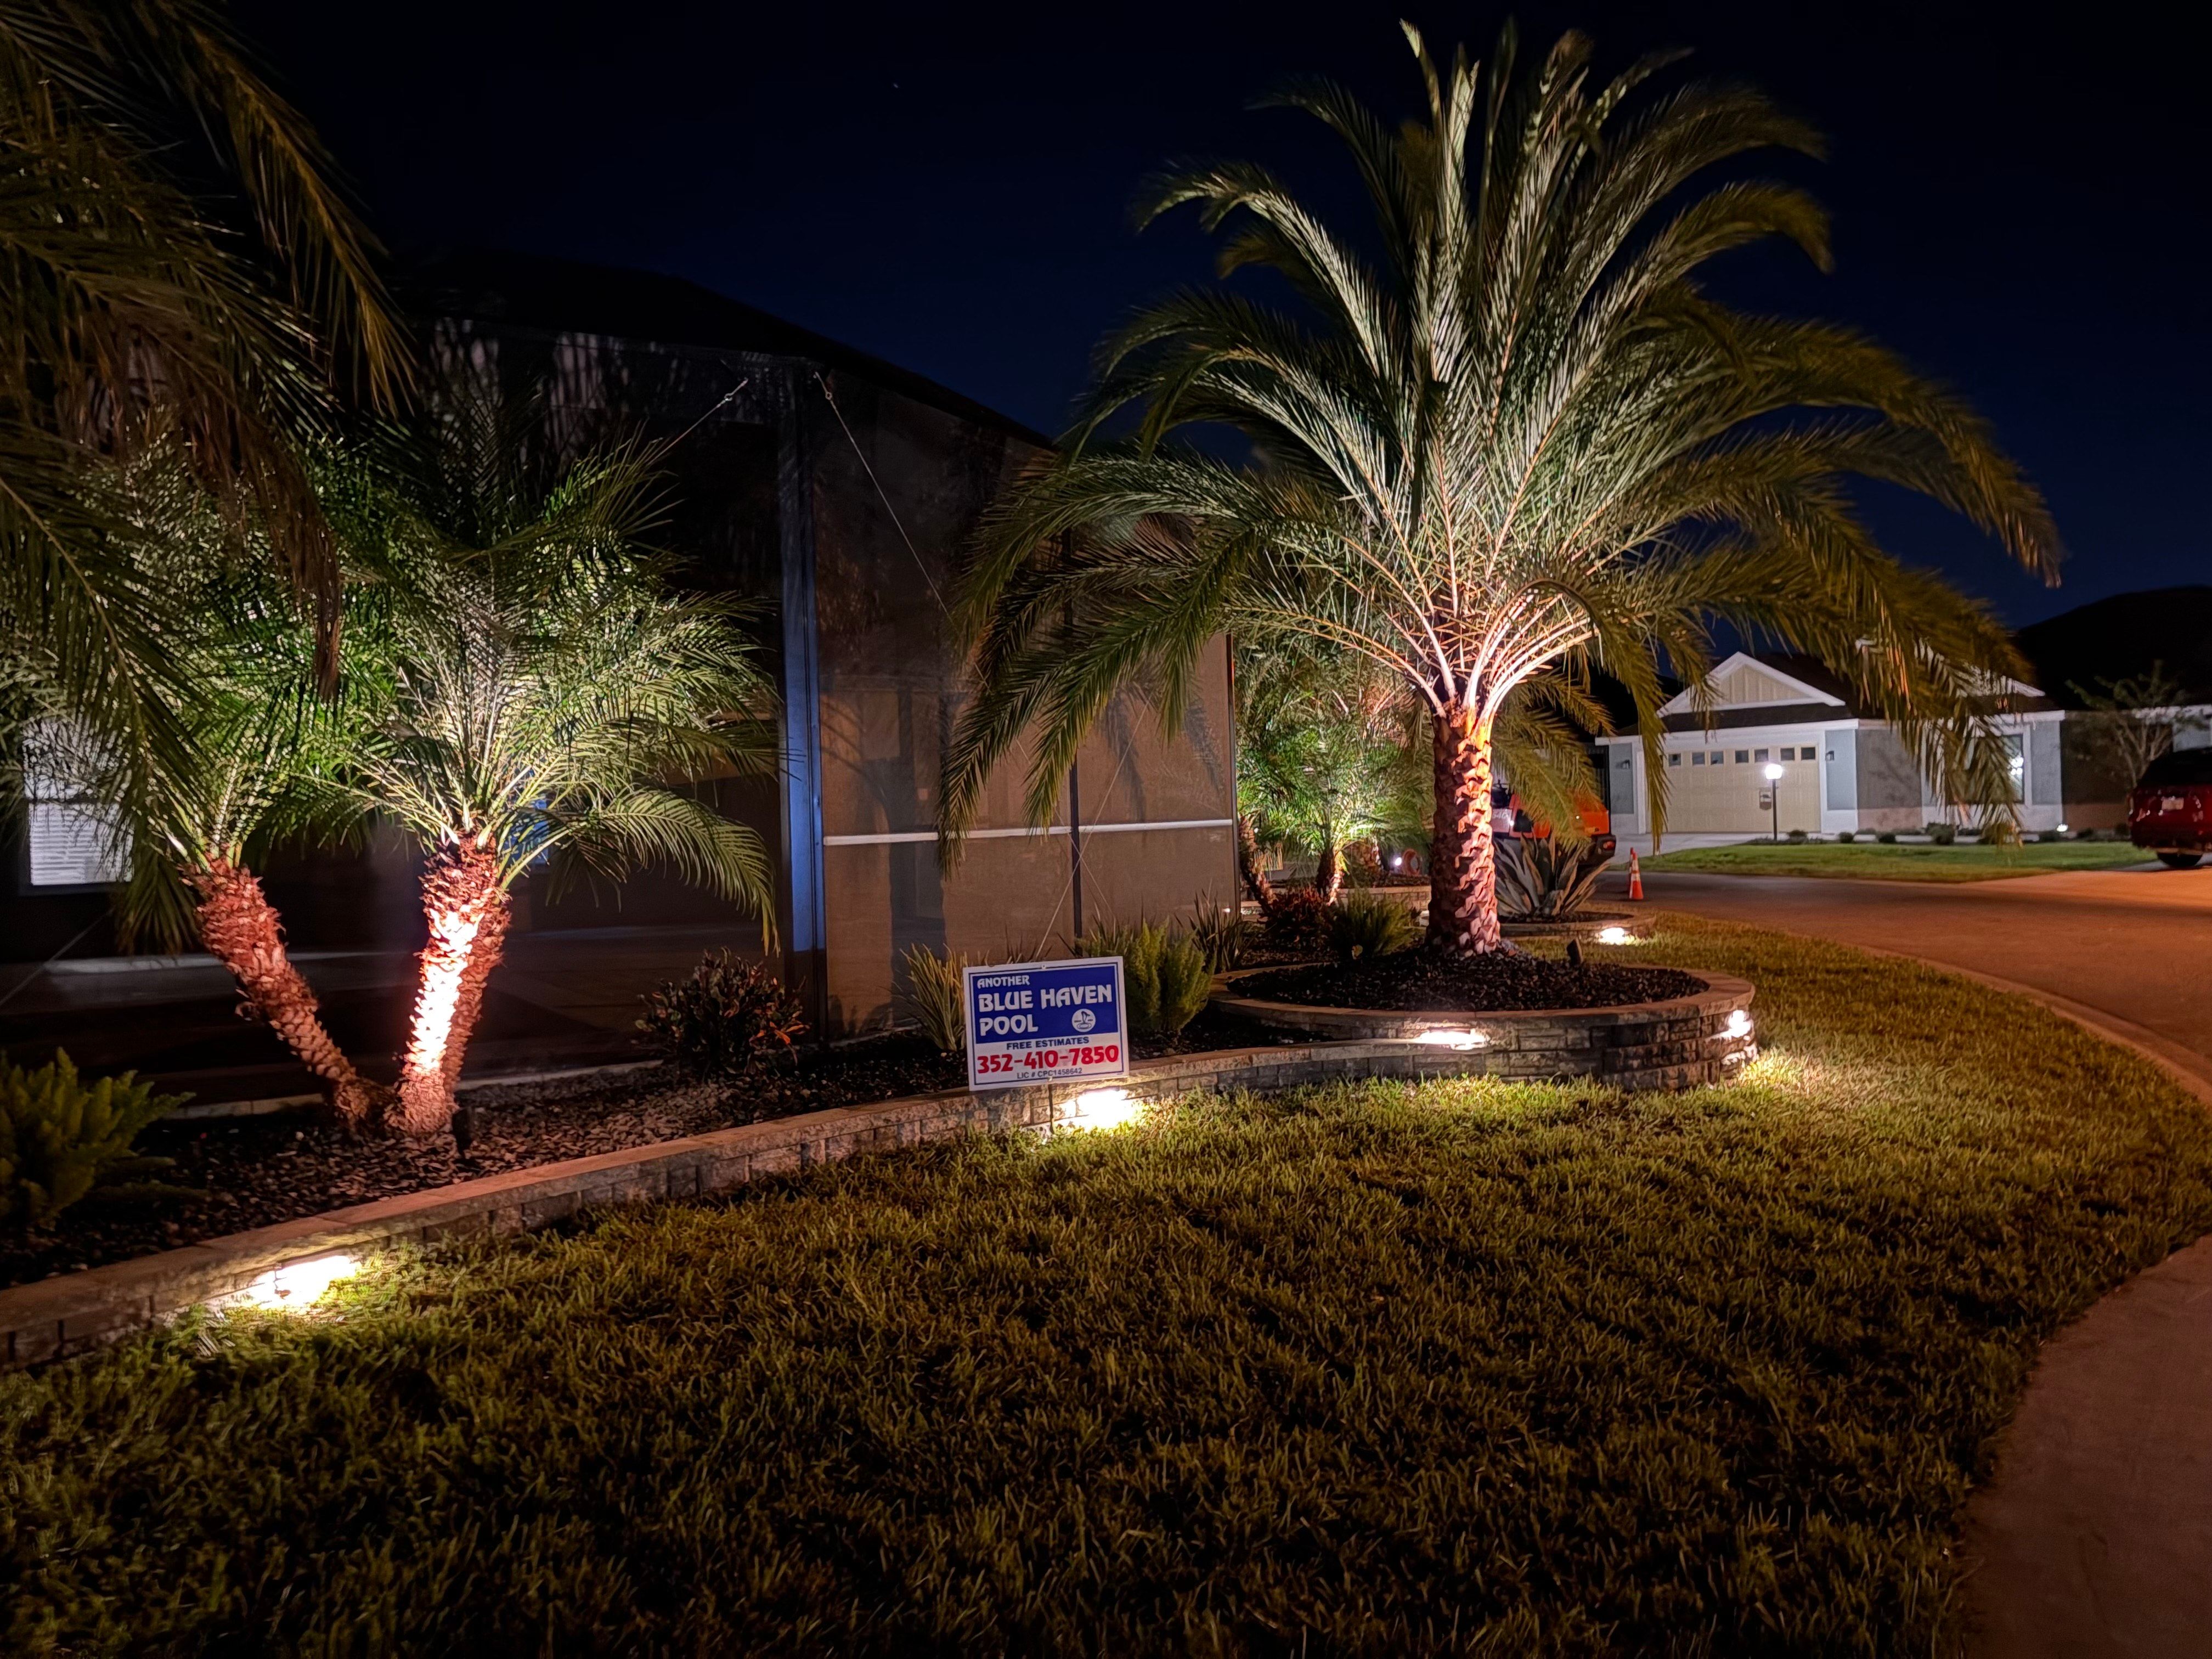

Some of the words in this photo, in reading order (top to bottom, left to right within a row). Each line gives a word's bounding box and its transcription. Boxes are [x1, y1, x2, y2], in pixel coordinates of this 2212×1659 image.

[977, 975, 1030, 989] ANOTHER
[978, 990, 1034, 1012] BLUE
[1040, 984, 1112, 1009] HAVEN
[979, 1014, 1039, 1036] POOL
[1007, 1041, 1032, 1050] FREE
[1035, 1036, 1089, 1048] ESTIMATES
[977, 1045, 1119, 1074] 352-410-7850
